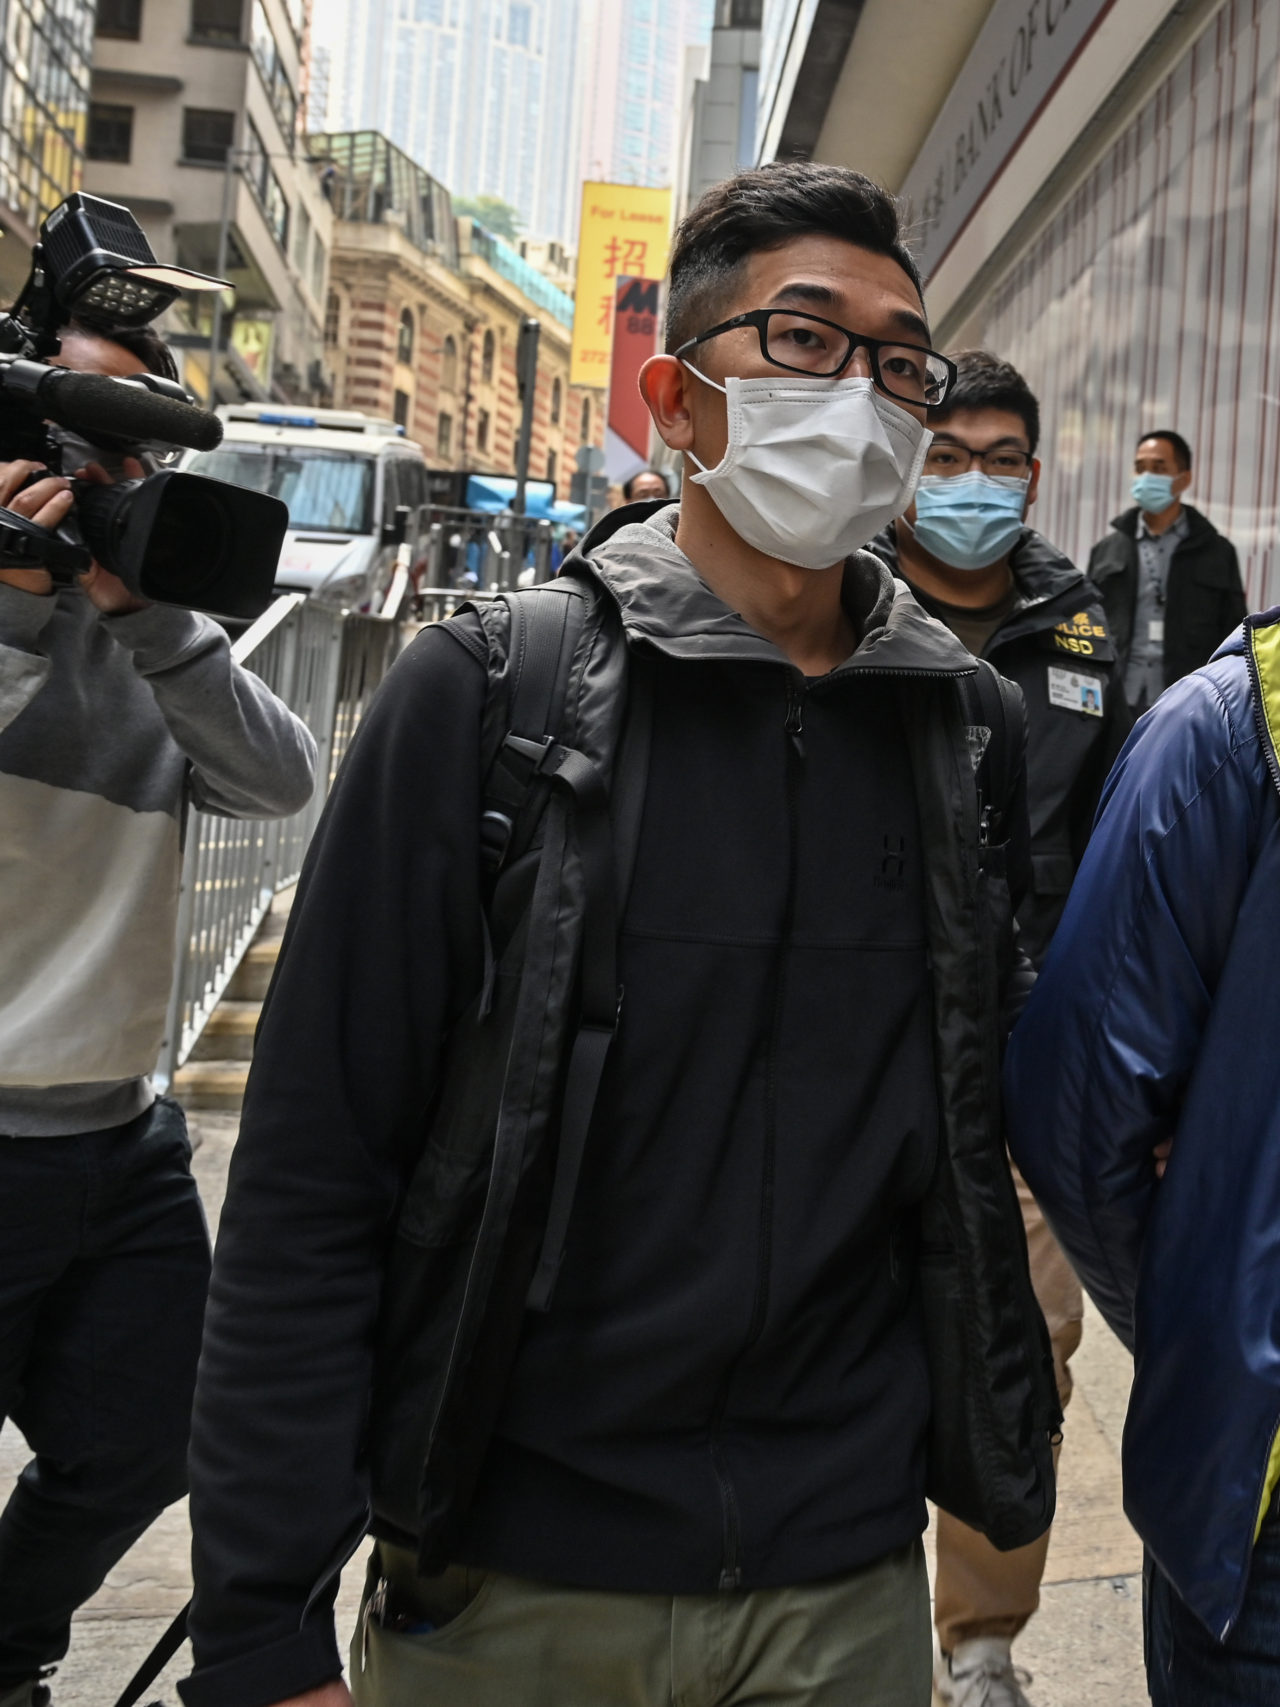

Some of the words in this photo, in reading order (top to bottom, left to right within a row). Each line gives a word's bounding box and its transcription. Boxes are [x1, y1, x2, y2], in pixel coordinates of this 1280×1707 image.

[952, 55, 1006, 195] BANK
[590, 204, 616, 219] For
[621, 209, 665, 225] Lease
[1054, 634, 1094, 655] NSD
